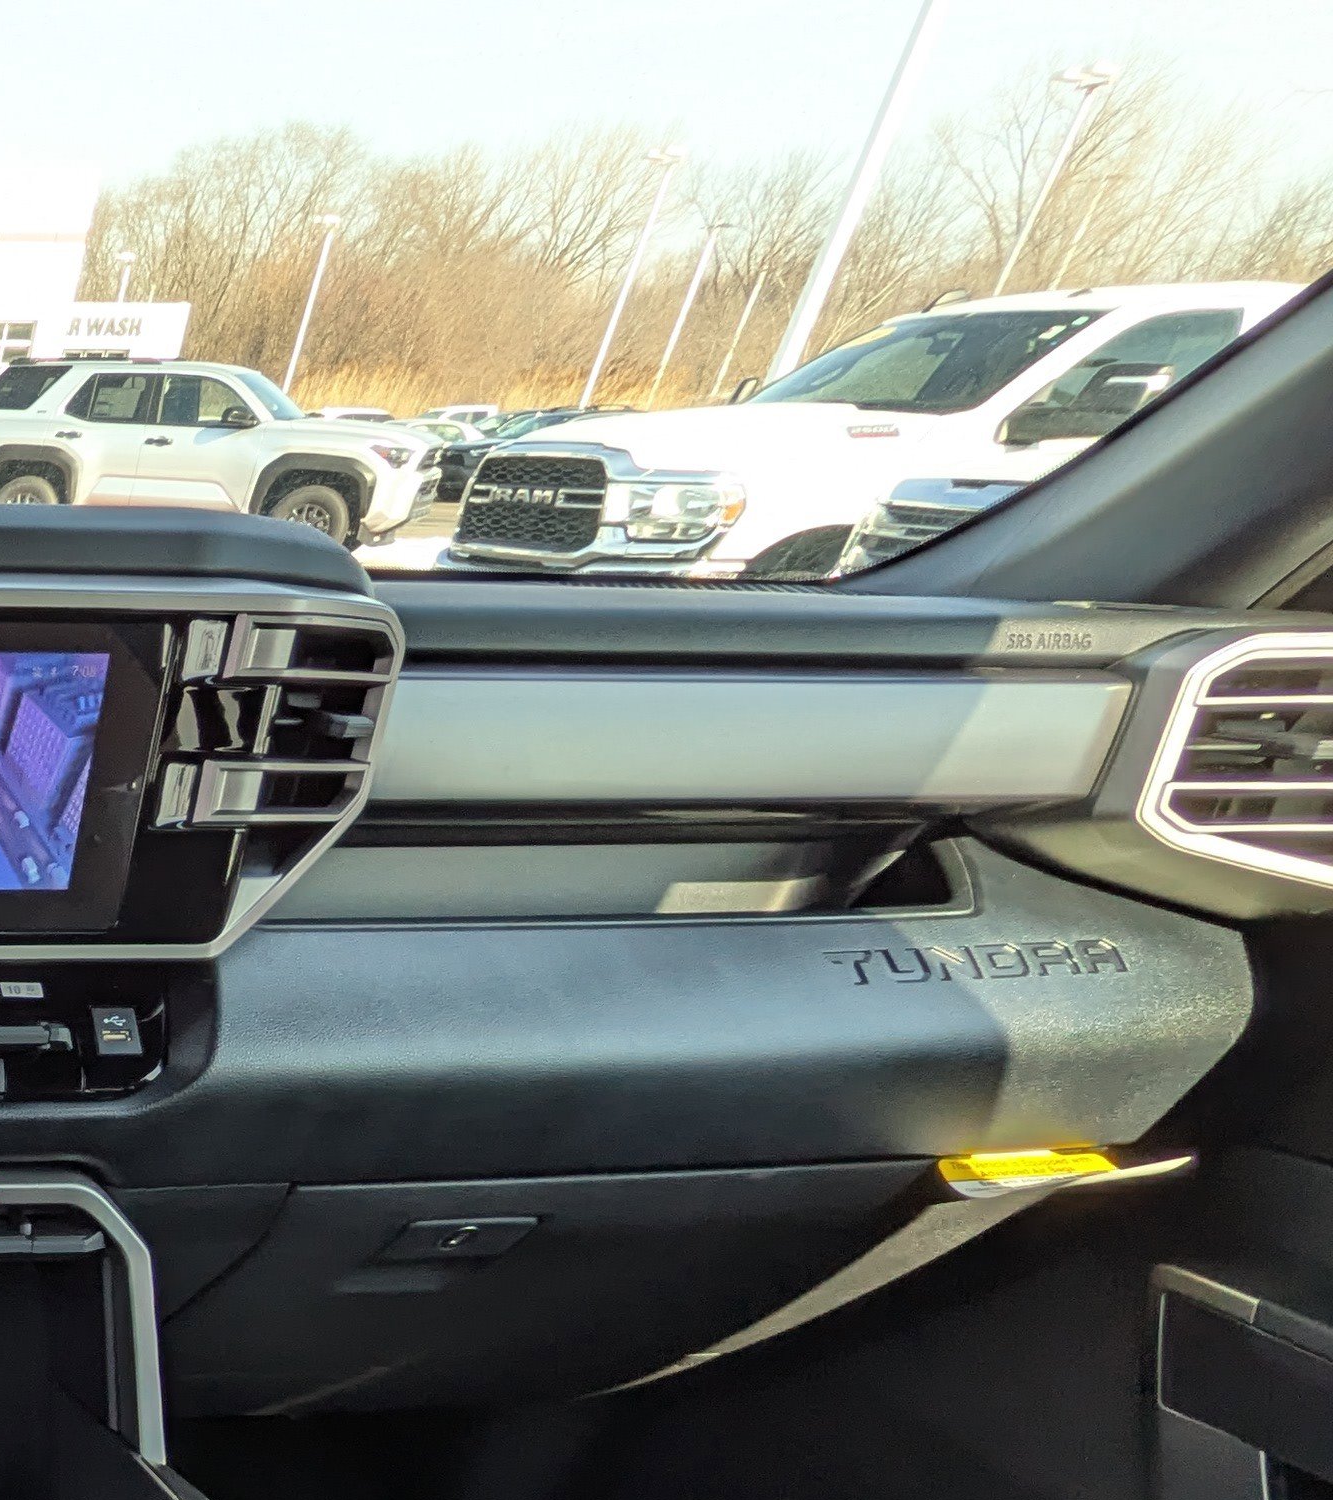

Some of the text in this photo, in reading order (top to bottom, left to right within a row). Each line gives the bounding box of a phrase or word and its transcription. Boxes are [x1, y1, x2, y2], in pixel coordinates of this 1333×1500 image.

[86, 316, 143, 337] WASH
[494, 488, 554, 504] RAM
[1006, 632, 1093, 650] SRS AIRBAG
[822, 939, 1129, 986] TUNDRA
